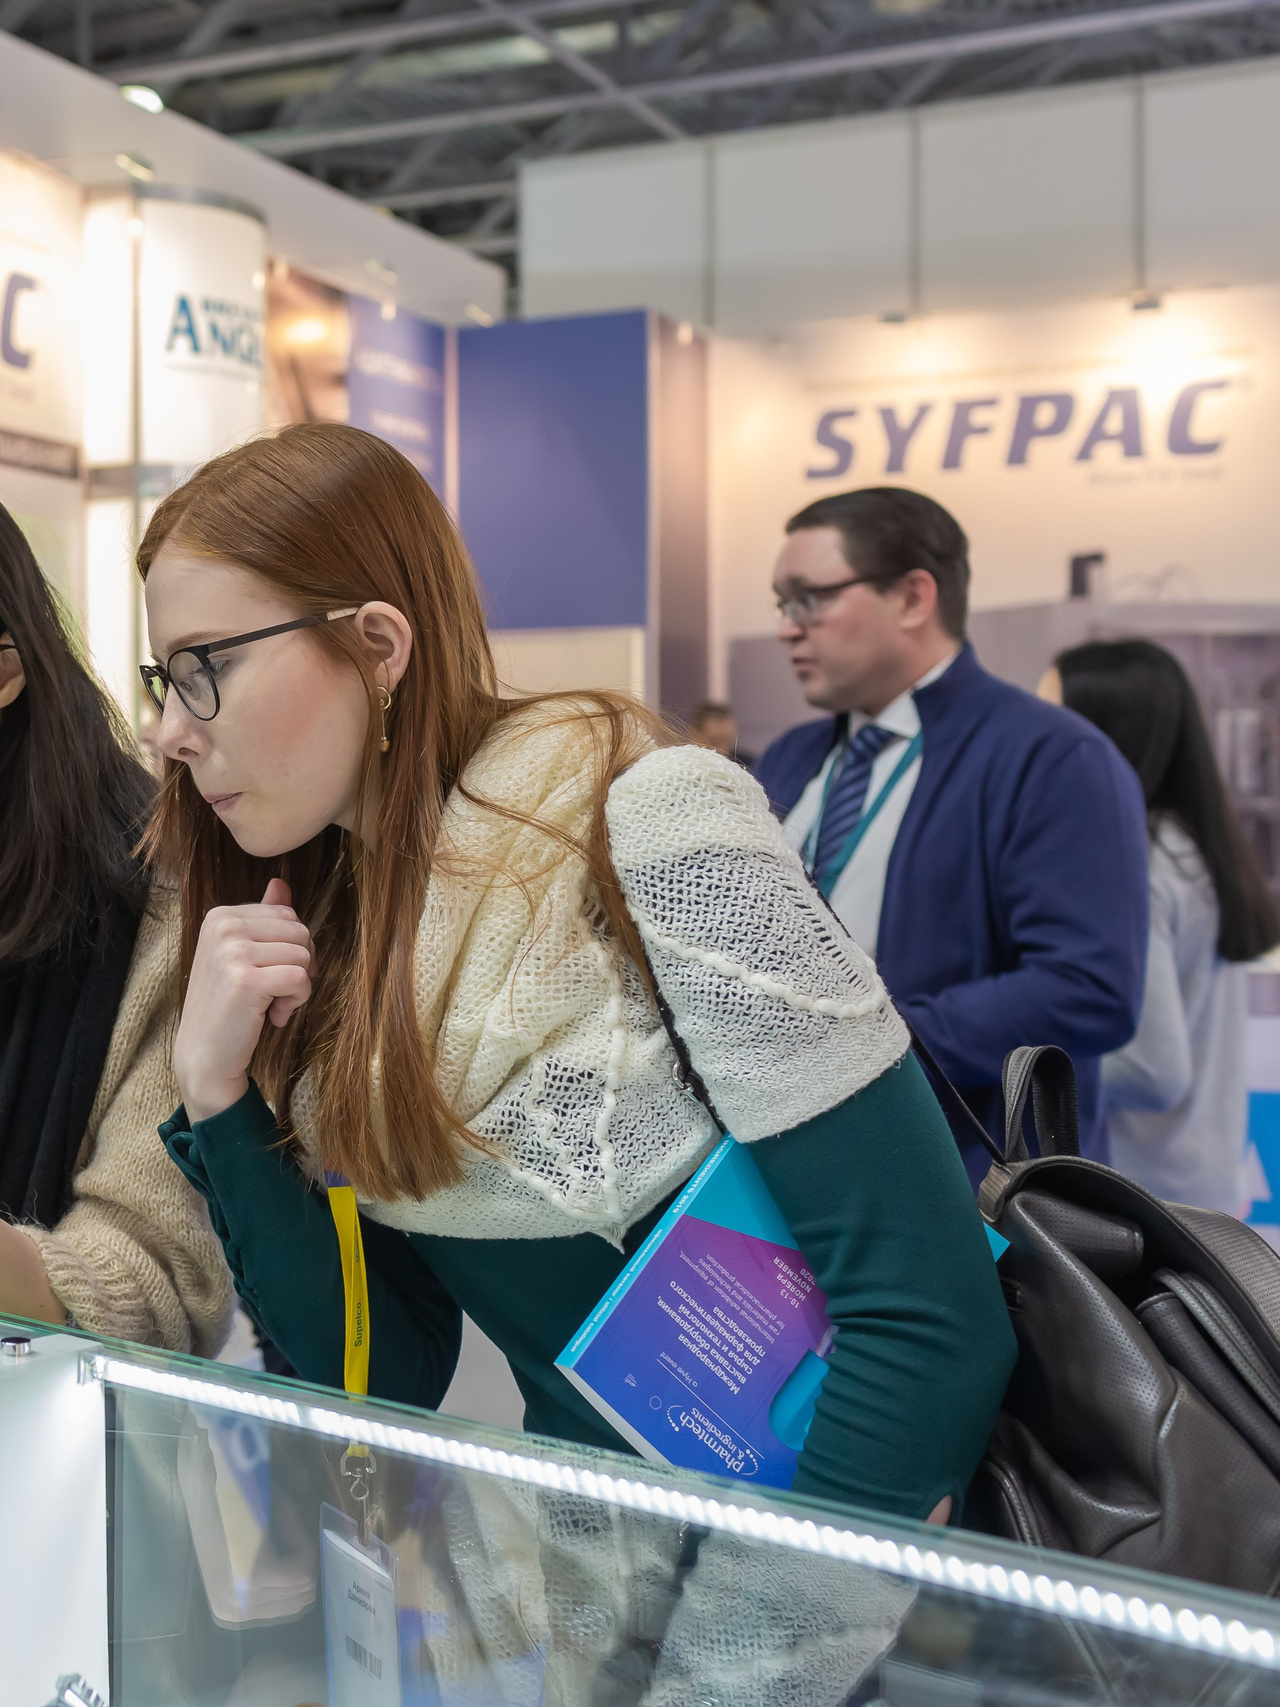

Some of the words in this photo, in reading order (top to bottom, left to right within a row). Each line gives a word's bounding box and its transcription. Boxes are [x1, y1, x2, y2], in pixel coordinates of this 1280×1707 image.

[807, 379, 1228, 479] SYFPAC
[686, 1138, 728, 1194] INGREDIENTS
[678, 1250, 708, 1280] equipment,
[697, 1258, 732, 1291] technologies
[705, 1253, 735, 1282] production
[772, 1256, 812, 1292] NOVEMBER
[799, 1267, 816, 1285] 2020
[713, 1285, 740, 1310] exhibition
[730, 1289, 743, 1301] and
[733, 1280, 776, 1320] pharmaceutical
[776, 1272, 806, 1300] НОЯБРЯ
[779, 1288, 800, 1308] 10-13
[354, 1301, 363, 1346] Supelco
[592, 1301, 609, 1322] official
[654, 1295, 710, 1350] оборудования,
[668, 1280, 744, 1351] фармацевтического
[677, 1303, 722, 1347] технологий
[739, 1309, 775, 1343] International
[742, 1299, 769, 1325] materials
[776, 1319, 785, 1329] for
[570, 1322, 593, 1352] catalogue
[712, 1306, 765, 1357] производства
[768, 1323, 780, 1335] raw
[659, 1351, 678, 1368] event
[720, 1344, 728, 1352] и
[727, 1350, 753, 1374] сырья
[743, 1349, 760, 1365] для
[676, 1366, 693, 1383] Hyve
[677, 1333, 740, 1394] Международная
[709, 1347, 747, 1383] выставка
[676, 1410, 745, 1473] pharmtech
[689, 1407, 737, 1452] ingredients
[735, 1448, 745, 1459] &
